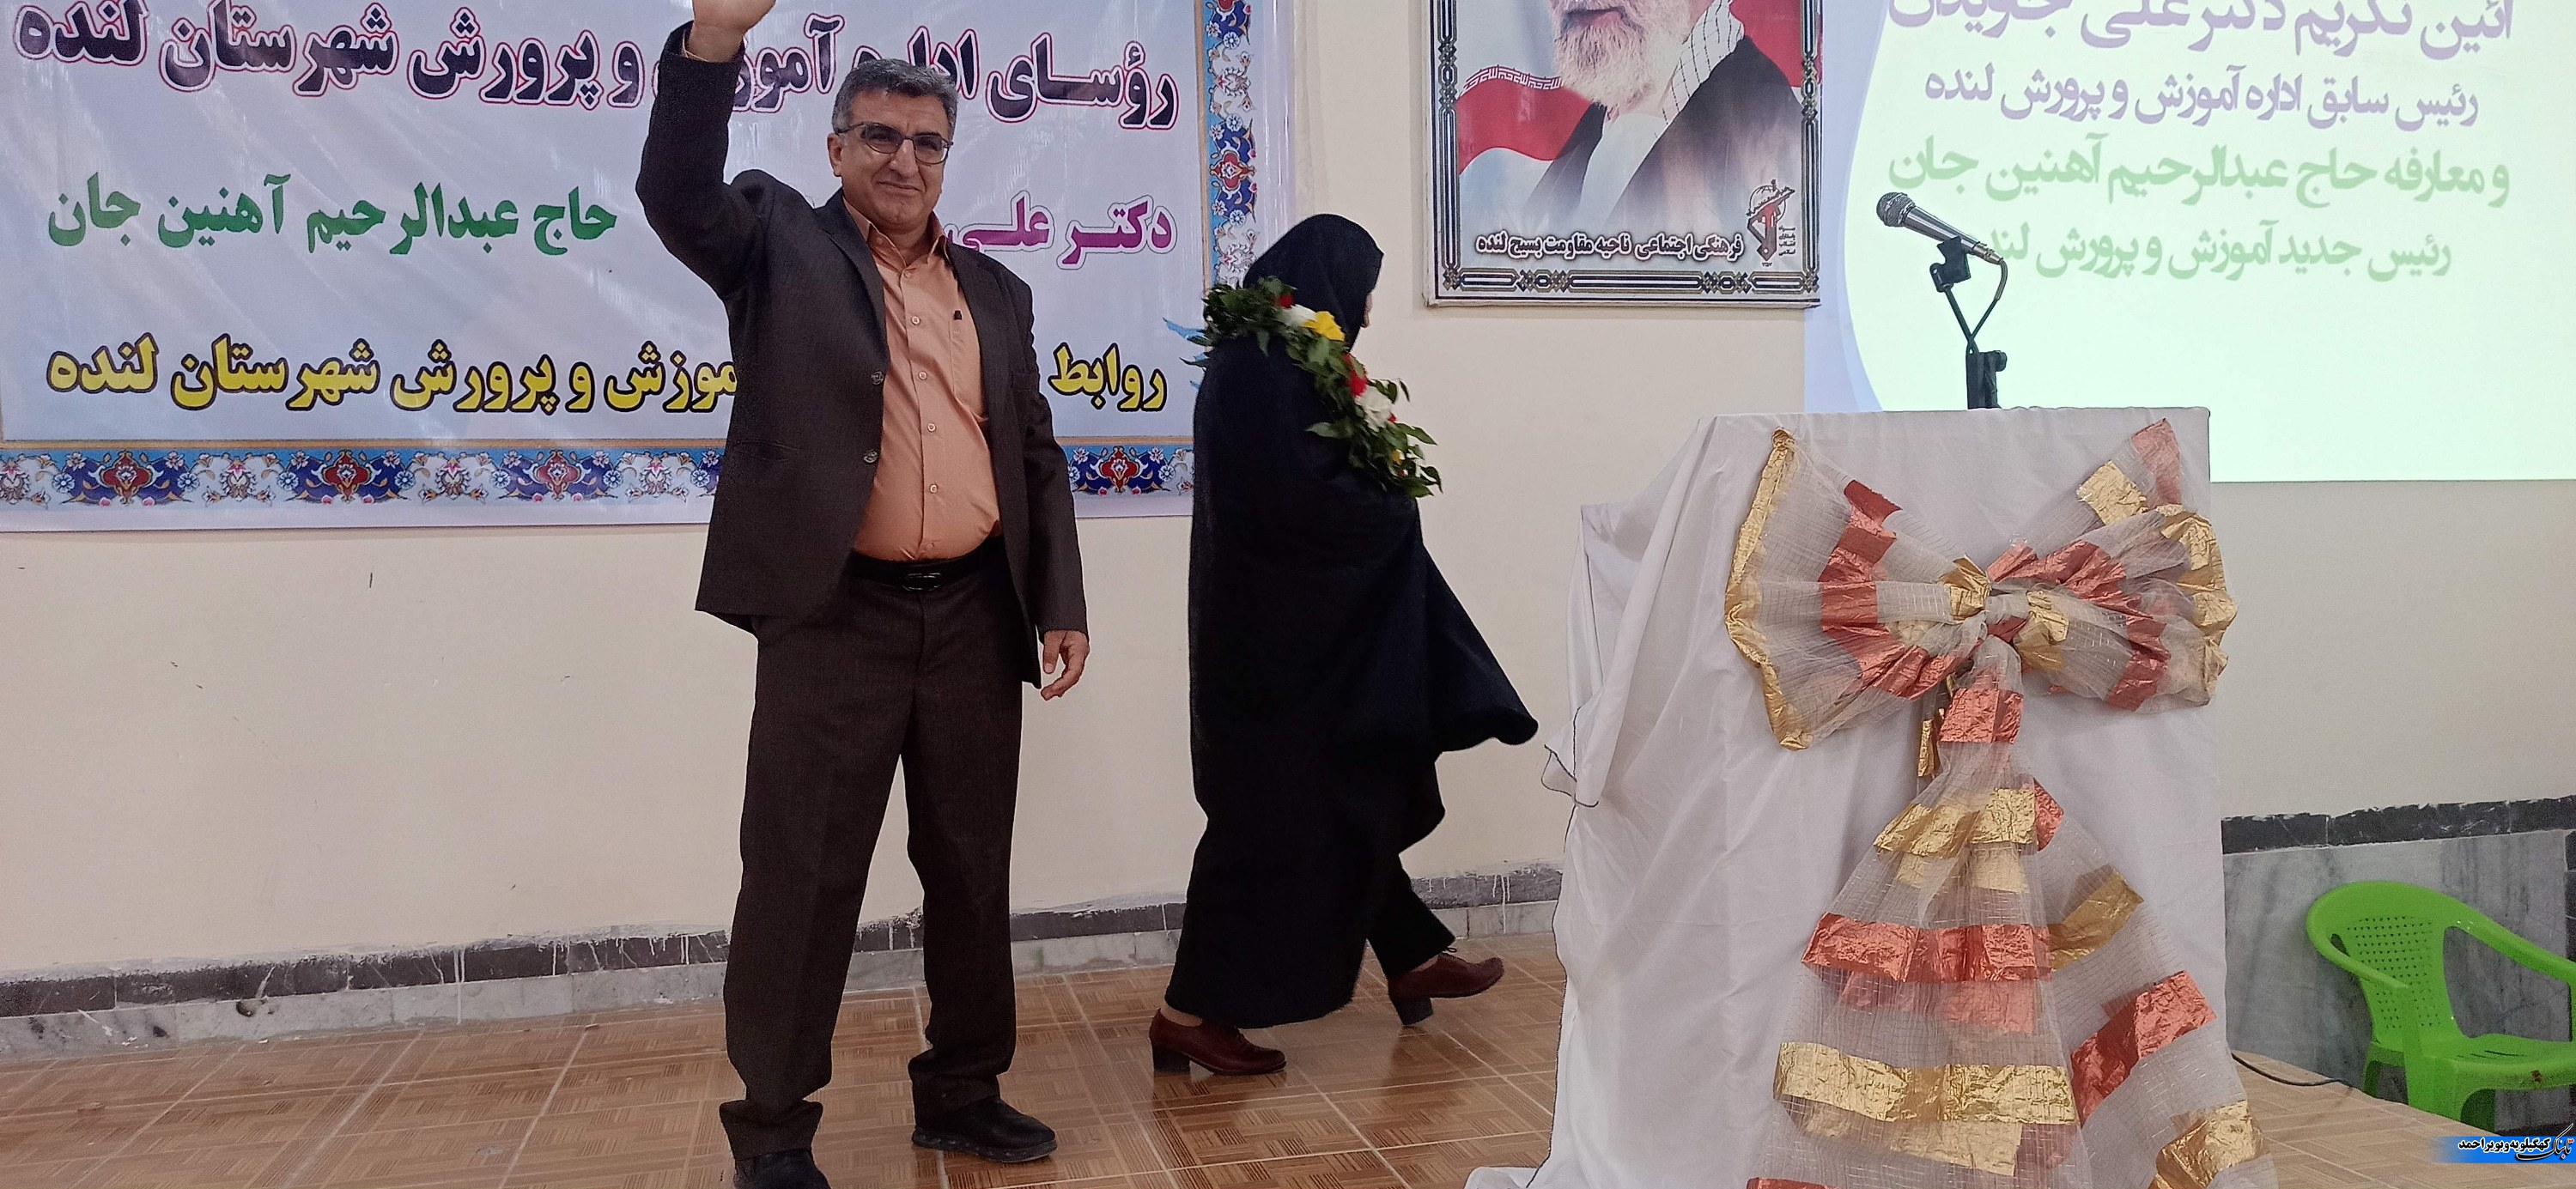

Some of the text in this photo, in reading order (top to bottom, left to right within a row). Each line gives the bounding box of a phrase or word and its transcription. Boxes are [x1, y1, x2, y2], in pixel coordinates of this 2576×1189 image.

[14, 0, 149, 66] لنده
[160, 0, 398, 96] شهرستان
[406, 6, 602, 109] پرورش
[607, 41, 644, 108] و
[987, 33, 1180, 129] رؤسای
[1925, 62, 2479, 131] رئیس سابق اداره آموزش و پرورش لنده
[1889, 132, 2510, 209] و معارفه حاج عبدالرحیم آهنین جان
[48, 173, 617, 256] حاج عبدالرحیم آهنین جان
[1057, 196, 1177, 270] دکتر
[1476, 229, 1508, 253] لنده
[1508, 235, 1543, 259] بسیج
[1545, 231, 1595, 260] مقاومت
[1595, 232, 1631, 259] ناحیه
[1635, 233, 1693, 260] اجتماعی
[1989, 219, 2451, 282] رئیس جدید آموزش و پرورش لند
[46, 332, 738, 415] موزش و پرورش شهرستان لنده
[1048, 342, 1168, 411] روابط
